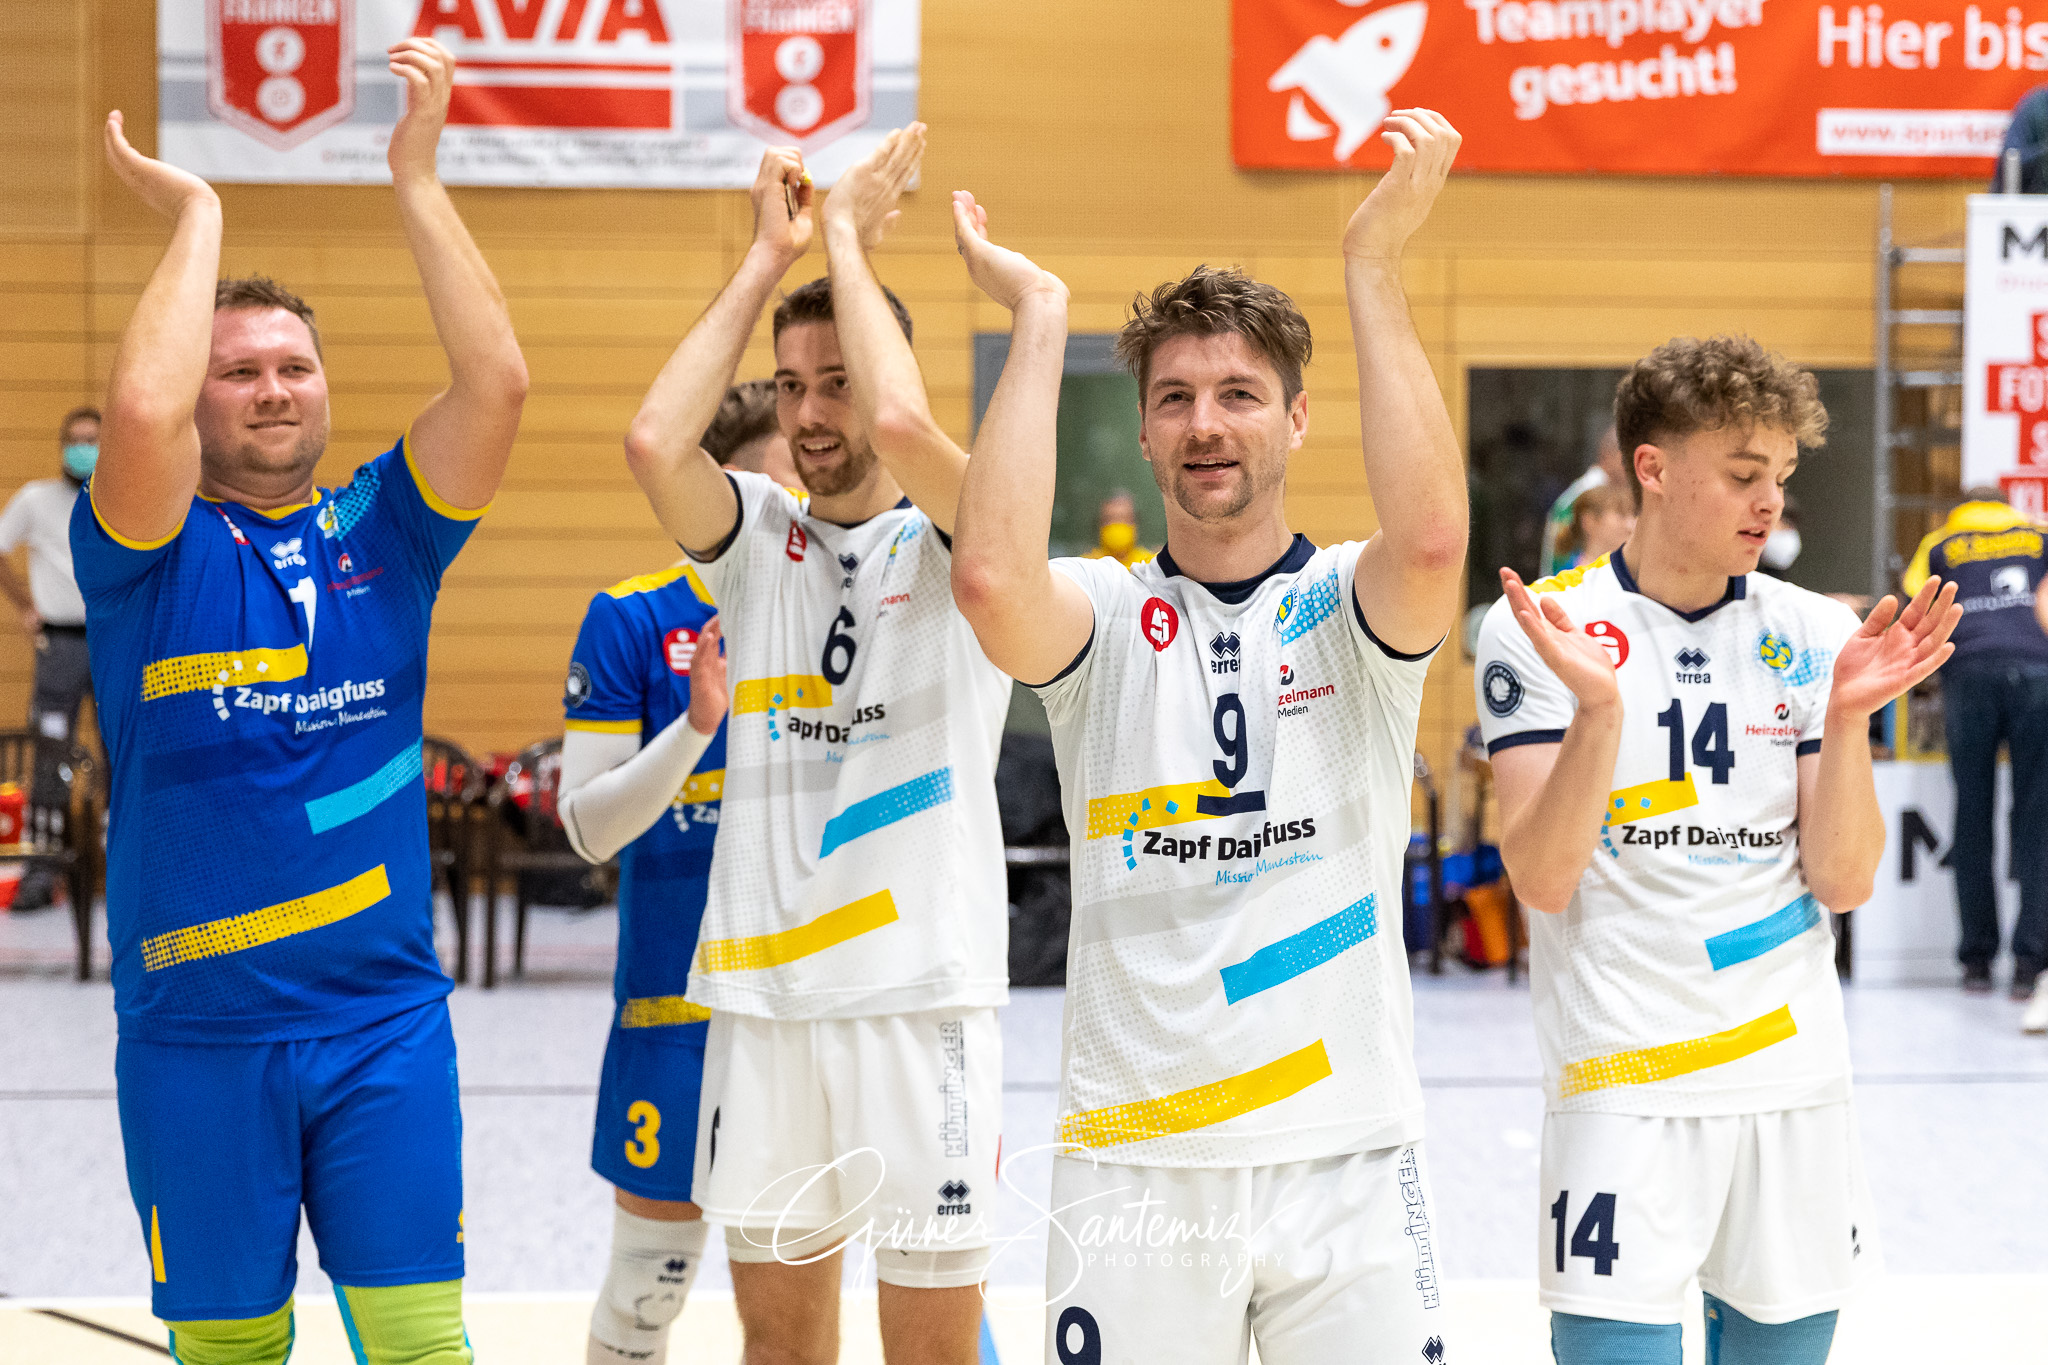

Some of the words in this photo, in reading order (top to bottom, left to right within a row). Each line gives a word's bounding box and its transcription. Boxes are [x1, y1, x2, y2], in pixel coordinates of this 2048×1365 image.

[412, 0, 672, 42] AVIA
[1466, 0, 1766, 48] Teamplayer
[1817, 3, 1954, 69] Hier
[1509, 42, 1738, 121] gesucht!
[821, 605, 857, 685] 6
[1210, 658, 1241, 675] erre
[233, 686, 292, 715] Zapf
[294, 678, 386, 714] Daigfuss
[1676, 672, 1711, 684] errea
[787, 716, 822, 741] apf
[1277, 705, 1308, 719] Medien
[1213, 693, 1248, 788] 9
[1657, 698, 1735, 784] 14
[1142, 831, 1211, 864] Zapf
[1218, 817, 1316, 861] Daifuss
[1622, 825, 1680, 850] Zapf
[1687, 825, 1783, 849] Daigfuss
[1215, 870, 1254, 886] Missio
[1255, 852, 1324, 877] Mauerstein
[624, 1099, 661, 1169] 3
[937, 1203, 971, 1216] errea
[1551, 1190, 1620, 1276] 14
